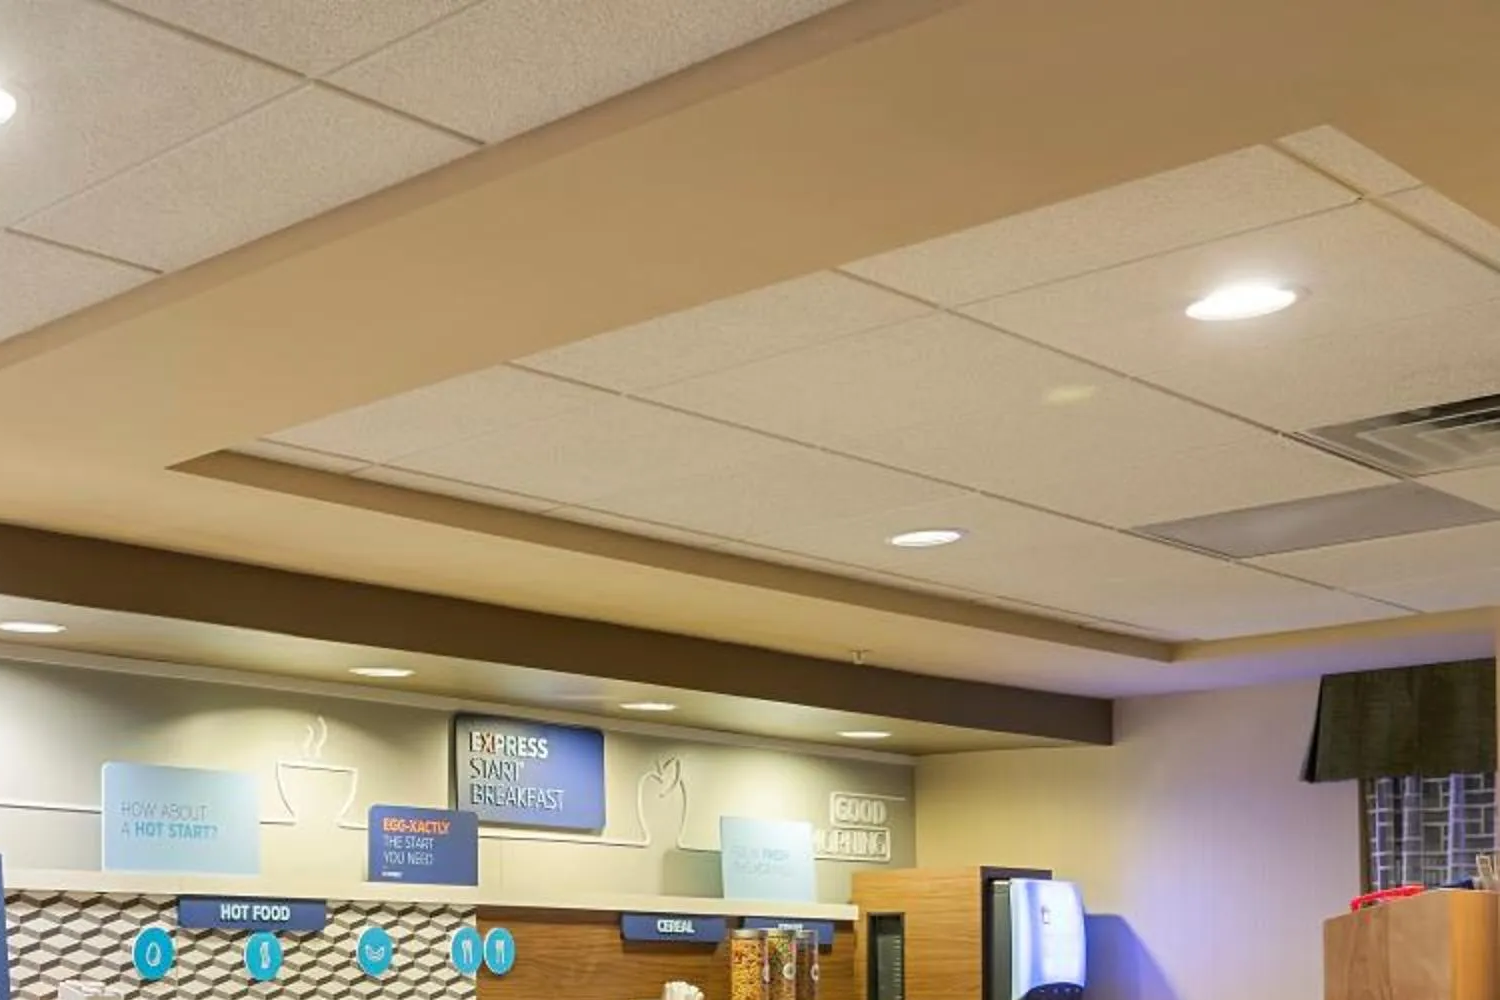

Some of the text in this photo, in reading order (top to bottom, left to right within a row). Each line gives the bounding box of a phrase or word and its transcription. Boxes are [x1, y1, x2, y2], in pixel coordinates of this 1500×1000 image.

[469, 731, 549, 759] EXPRESS
[470, 784, 565, 811] BREAKFAST
[120, 801, 208, 822] HOW ABOUT
[835, 797, 887, 825] GOOD
[120, 822, 219, 841] A HOT START?
[381, 818, 451, 835] EGG-XACTLY
[383, 834, 435, 852] THE START
[382, 851, 434, 866] YOU NEED
[220, 904, 290, 921] HOT FOOD
[656, 919, 695, 934] CEREAL
